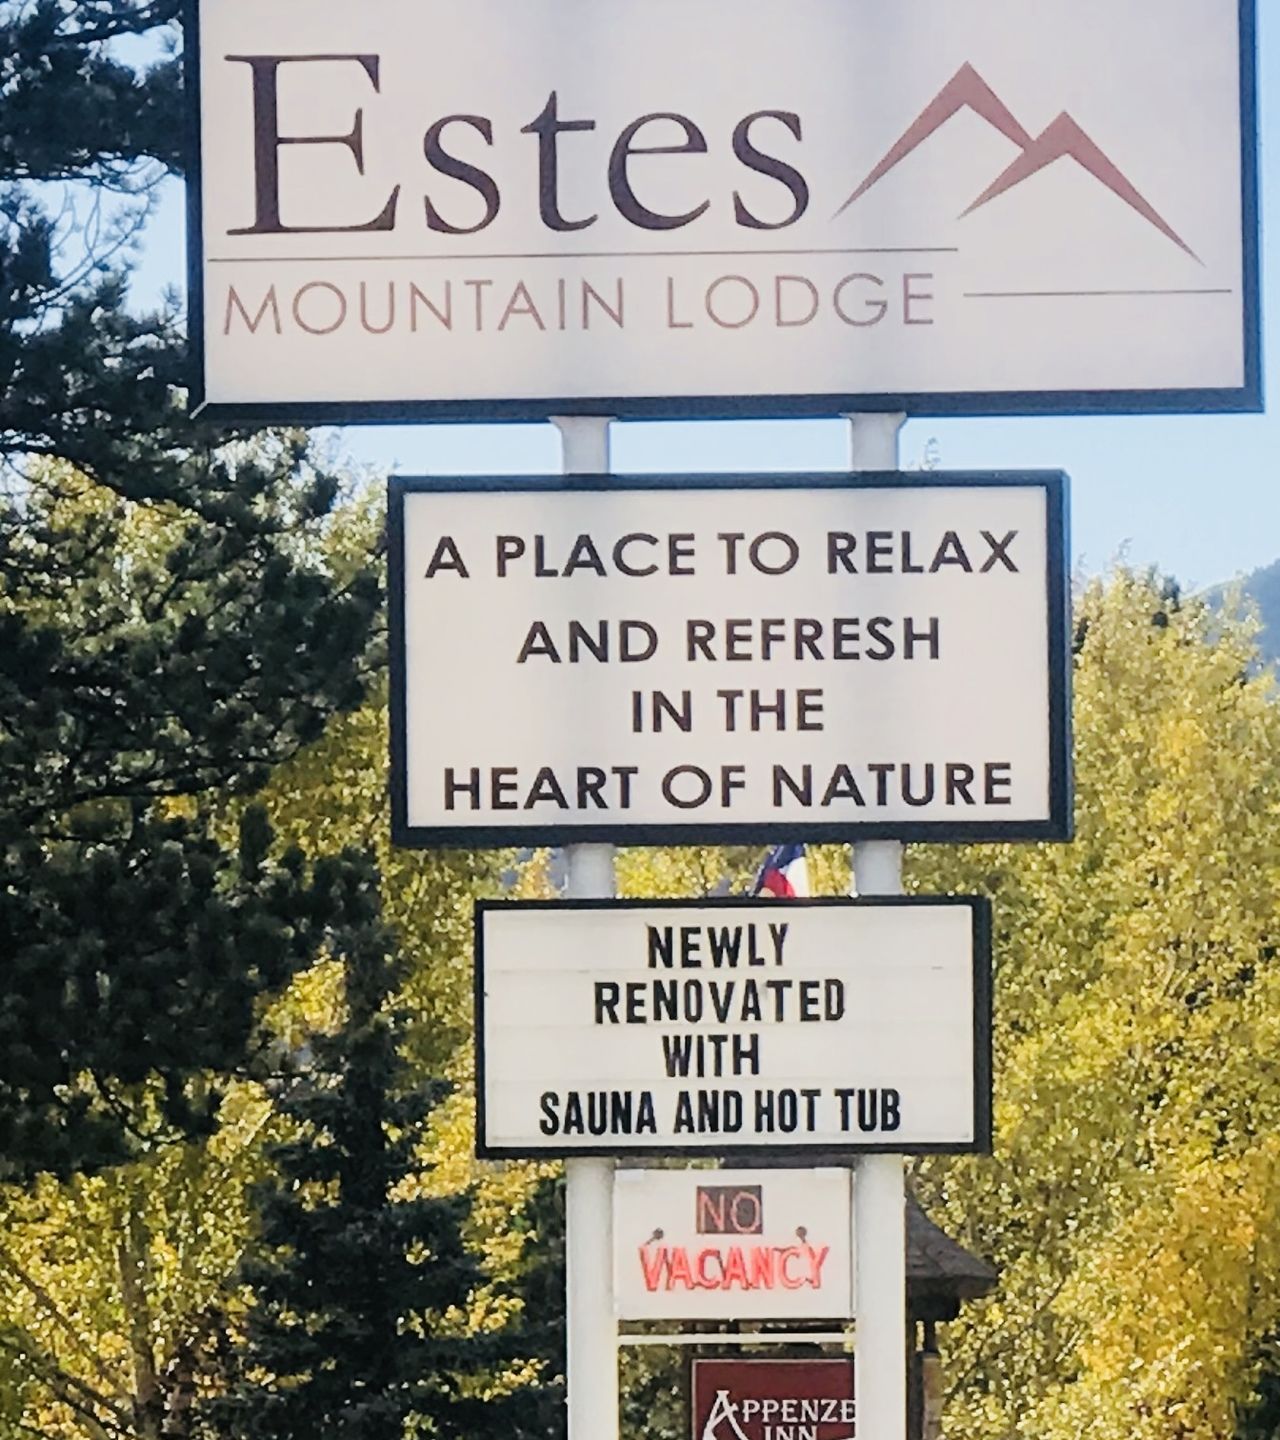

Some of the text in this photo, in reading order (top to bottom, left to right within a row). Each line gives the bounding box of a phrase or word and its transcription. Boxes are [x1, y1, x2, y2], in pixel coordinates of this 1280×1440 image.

[223, 54, 810, 236] Estes
[223, 272, 934, 336] MOUNTAIN LODGE
[424, 530, 1019, 579] A PLACE TO RELAX
[516, 616, 939, 664] AND REFRESH
[632, 688, 824, 733] IN THE
[444, 762, 1011, 811] HEART OF NATURE
[647, 923, 788, 969] NEWLY
[594, 978, 845, 1025] RENOVATED
[661, 1033, 760, 1078] WITH
[539, 1088, 901, 1136] SAUNA AND HOT TUB
[698, 1191, 761, 1234] NO
[639, 1243, 829, 1293] VACANCY
